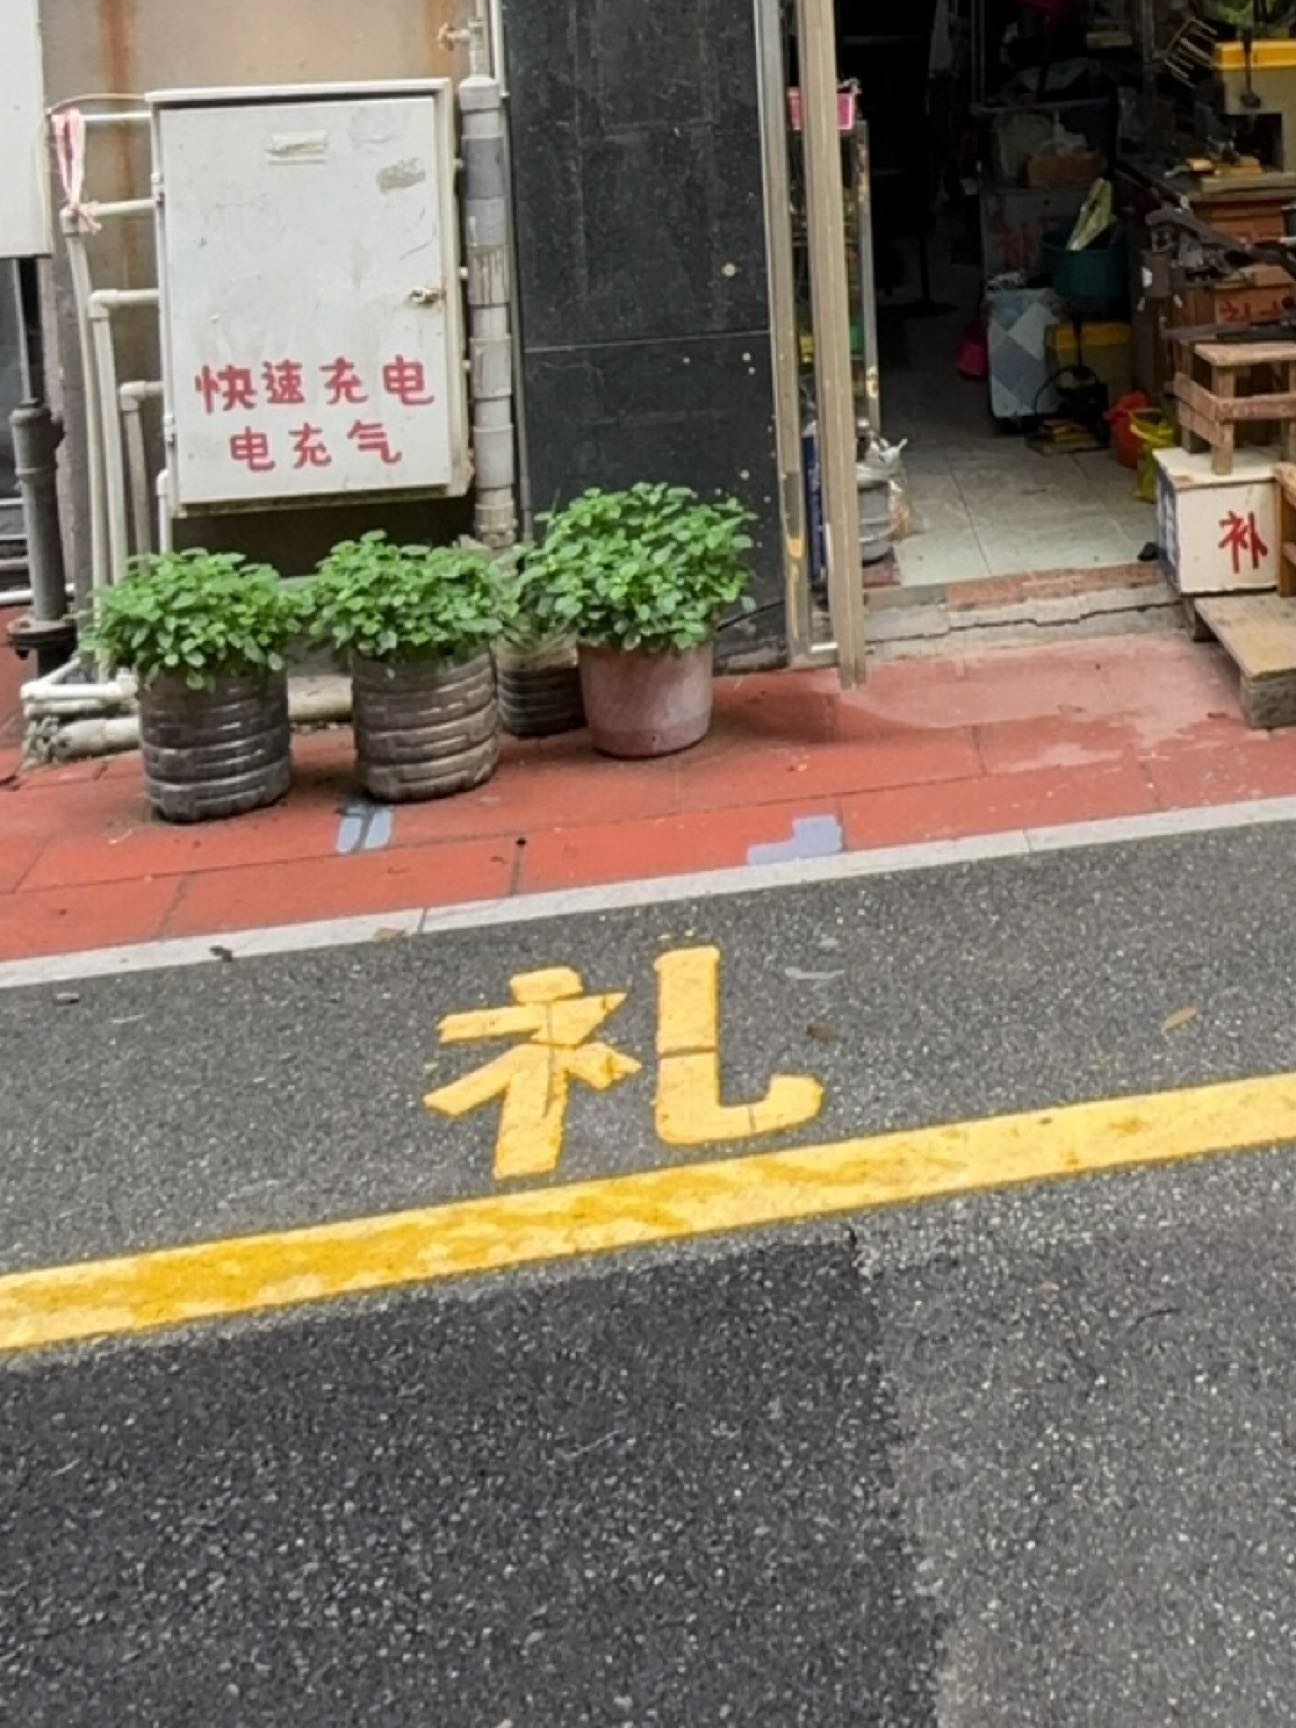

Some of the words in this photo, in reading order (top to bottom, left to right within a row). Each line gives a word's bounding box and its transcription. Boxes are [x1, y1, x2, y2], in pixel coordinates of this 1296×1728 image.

[194, 354, 436, 415] 快速充电
[228, 418, 403, 473] 电充气
[1218, 510, 1269, 575] 补
[422, 944, 825, 1181] 礼
